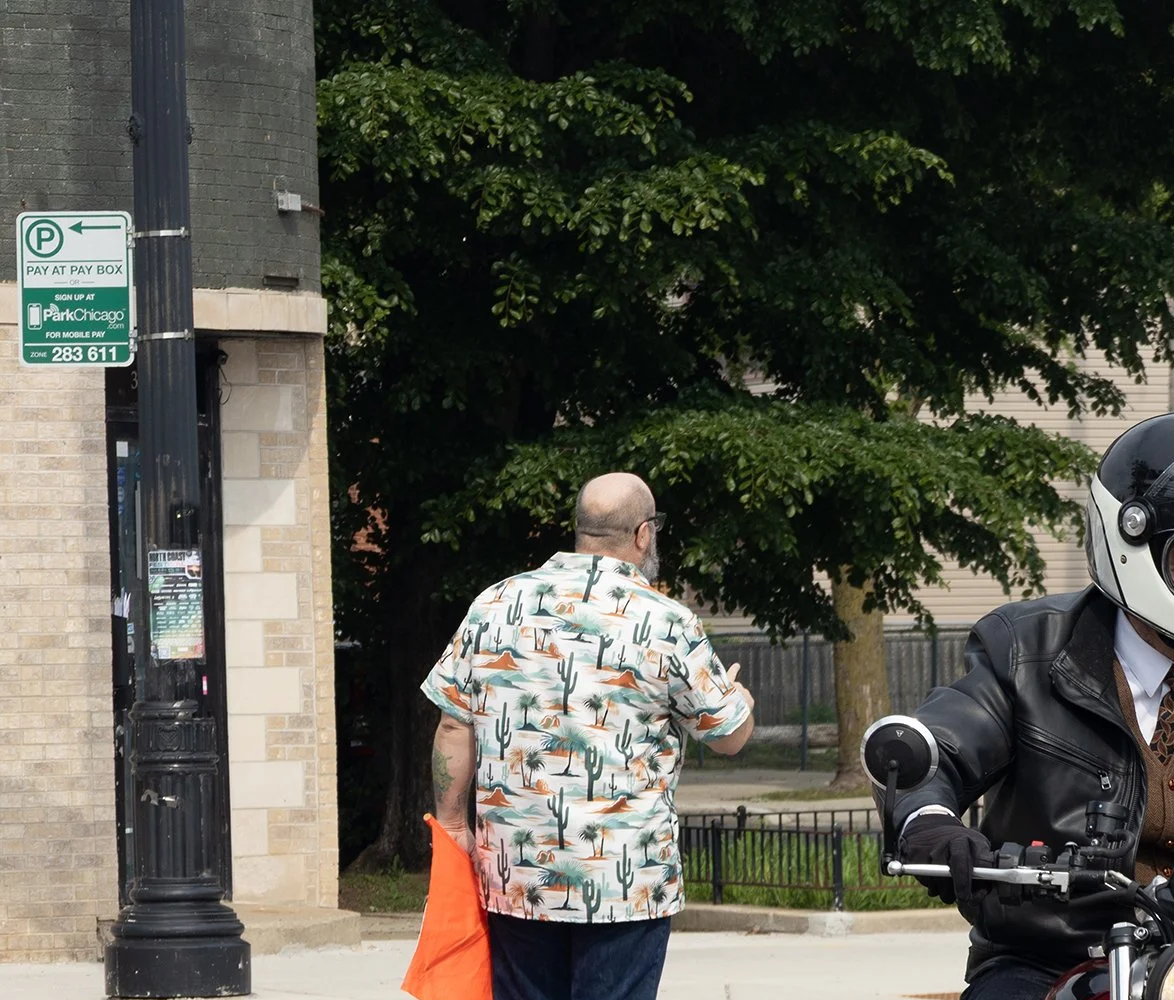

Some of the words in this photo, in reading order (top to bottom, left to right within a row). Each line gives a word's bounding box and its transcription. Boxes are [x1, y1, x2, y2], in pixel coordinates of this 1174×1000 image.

[36, 227, 55, 250] P
[26, 266, 49, 275] PAY
[52, 265, 66, 275] AT
[70, 265, 93, 275] PAY
[97, 264, 123, 275] BOX
[43, 308, 124, 323] ParkChicago
[62, 331, 90, 339] MOBILE
[52, 347, 83, 362] 283
[87, 347, 117, 361] 611
